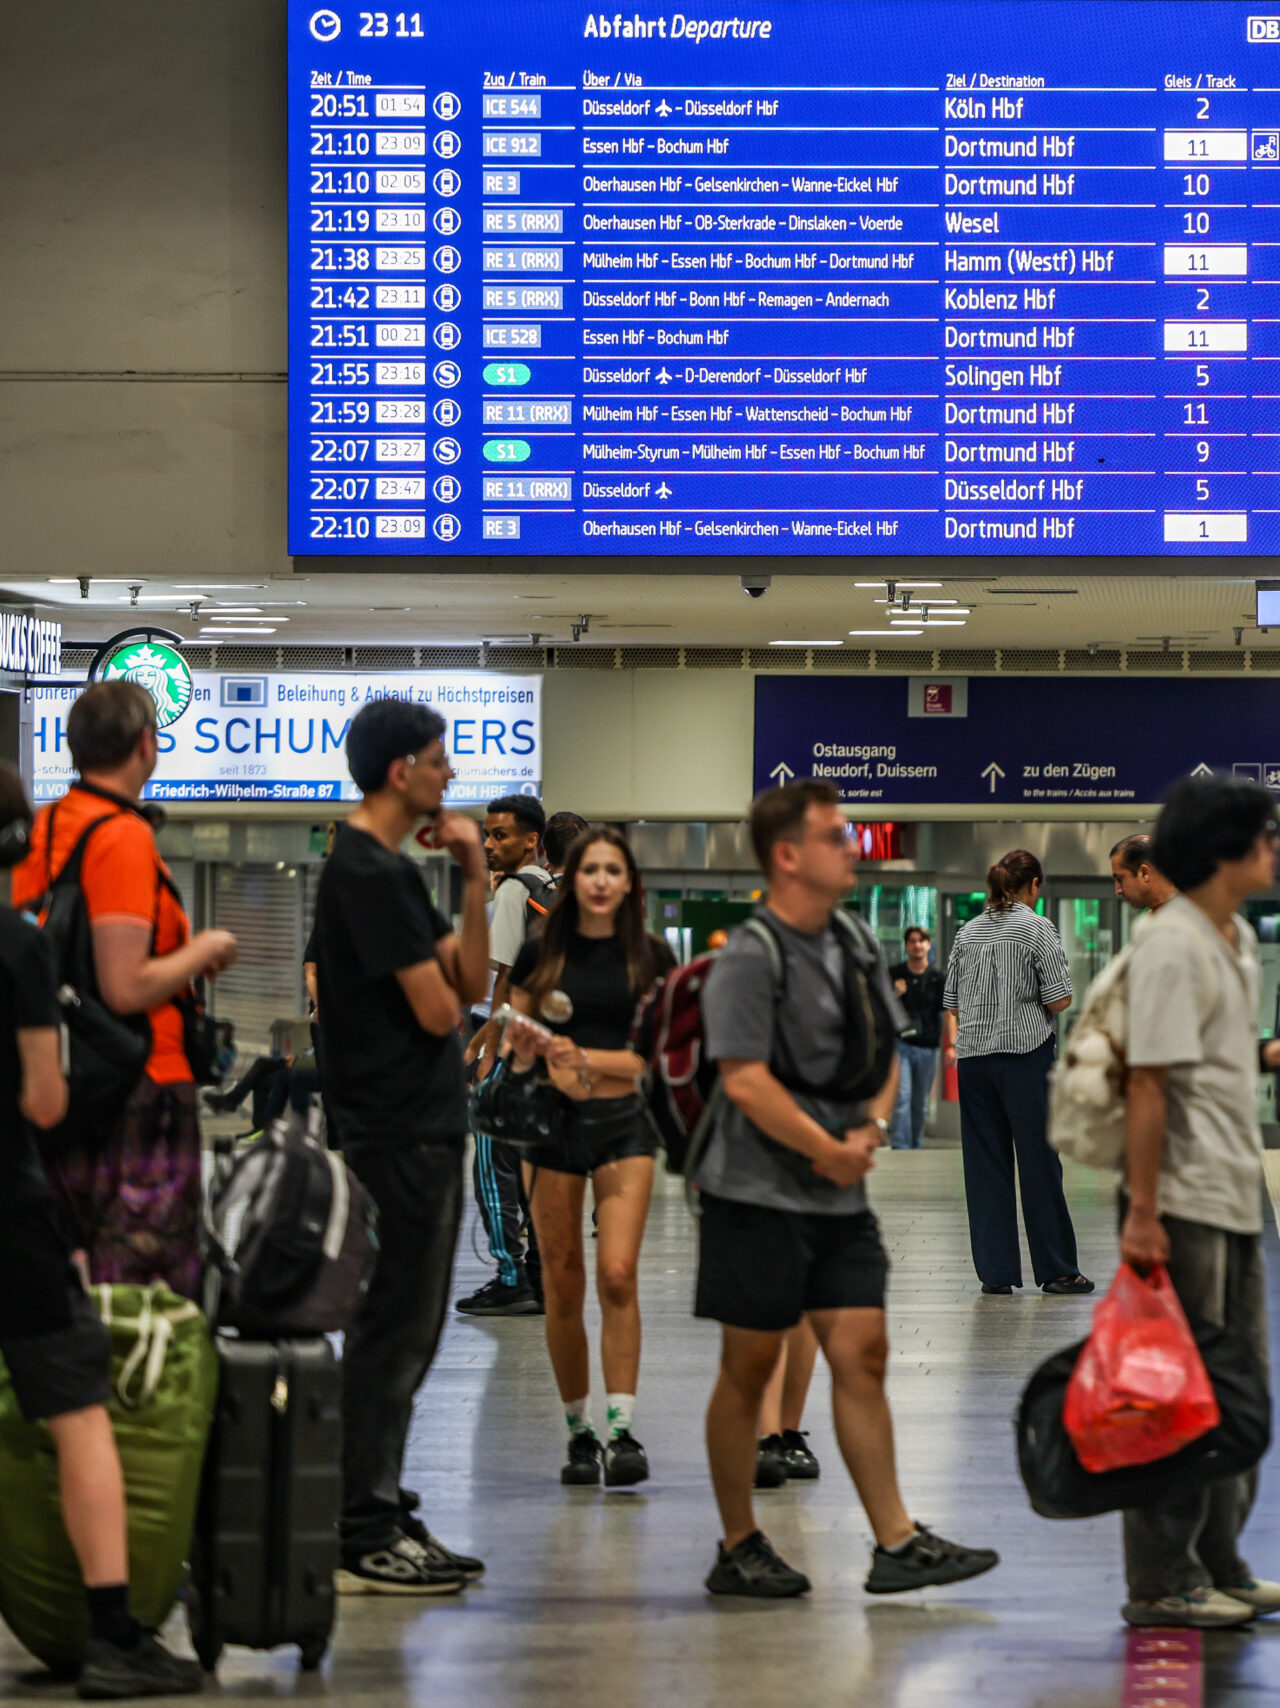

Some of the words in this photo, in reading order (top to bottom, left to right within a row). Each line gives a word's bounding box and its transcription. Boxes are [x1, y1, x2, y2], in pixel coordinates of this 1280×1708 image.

[583, 13, 667, 39] Abfahrt
[670, 13, 773, 45] Departure
[1251, 20, 1280, 39] DB
[310, 324, 370, 347] 21:51
[381, 327, 420, 342] 00:21
[486, 328, 507, 345] ICE
[510, 328, 538, 345] 528
[582, 328, 619, 345] Essen
[622, 329, 645, 345] Hbf
[657, 328, 704, 345] Bochum
[706, 329, 730, 345] Hbf
[944, 325, 1038, 348] Dortmund
[1042, 326, 1075, 348] Hbf
[1188, 330, 1209, 348] 11
[310, 362, 370, 386] 21:55
[381, 365, 421, 380] 23:16
[496, 366, 517, 383] S1
[945, 364, 1024, 392] Solingen
[1029, 364, 1062, 387] Hbf
[1196, 364, 1210, 387] 5
[310, 477, 370, 500] 22:07
[380, 480, 421, 495] 23:47
[486, 481, 504, 498] RE
[507, 481, 525, 498] 11
[529, 481, 568, 499] (RRX)
[582, 481, 651, 498] Düsseldorf
[944, 478, 1046, 501] Düsseldorf
[1051, 479, 1084, 501] Hbf
[1196, 478, 1210, 501] 5
[277, 684, 345, 706] Beleihung
[350, 686, 360, 702] &
[364, 685, 413, 703] Ankauf
[418, 690, 433, 703] zu
[437, 685, 535, 708] Höchstpreisen
[194, 717, 537, 756] SCHUMERS
[813, 742, 896, 761] Ostausgang
[218, 764, 239, 775] seit
[242, 764, 268, 775] 1873
[812, 762, 873, 779] Neudorf,
[876, 763, 937, 778] Duissern
[1023, 766, 1040, 777] zu
[1043, 763, 1069, 777] den
[1072, 763, 1116, 781] Zügen
[151, 783, 315, 799] Friedrich-Wilhelm-Straße
[317, 783, 334, 798] 87
[449, 784, 478, 799] VOM
